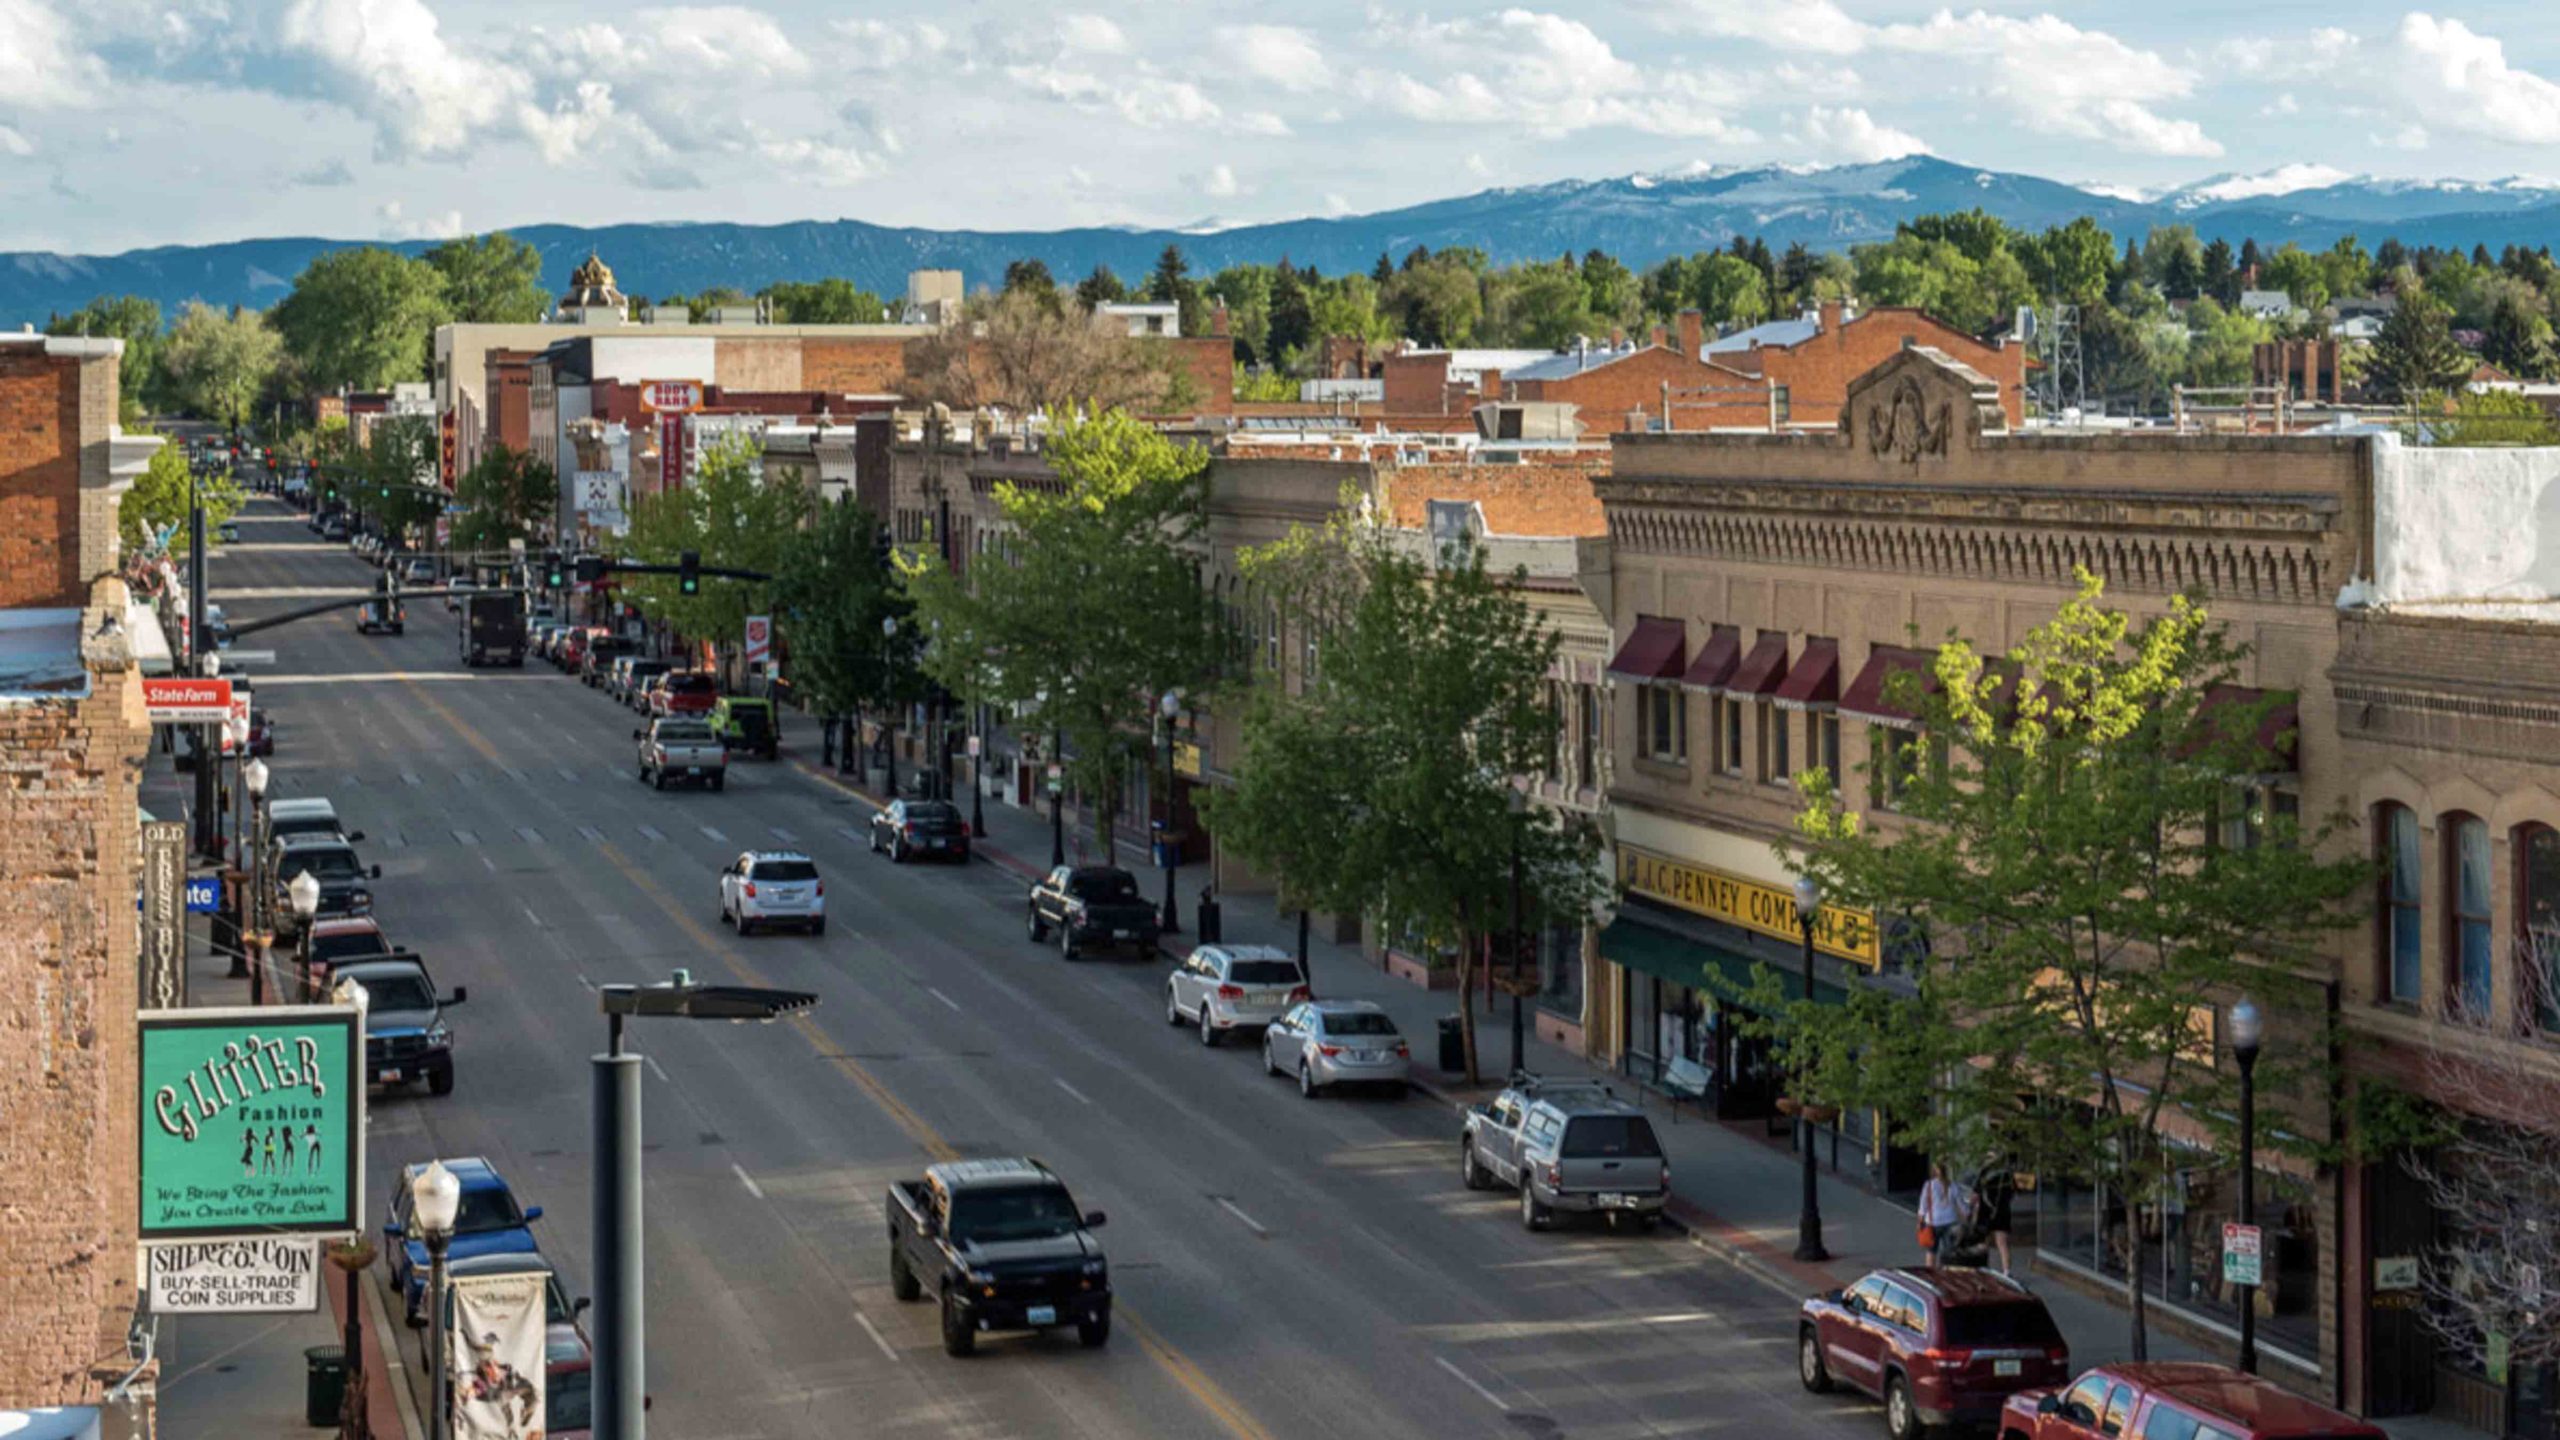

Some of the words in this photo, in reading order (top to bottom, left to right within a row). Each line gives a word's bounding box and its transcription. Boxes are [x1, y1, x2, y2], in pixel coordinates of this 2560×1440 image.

[146, 827, 184, 842] OLD
[1749, 890, 1836, 945] COMPNY
[154, 1033, 326, 1143] GLITTER
[239, 1106, 323, 1121] Fashion
[157, 1186, 181, 1201] We
[186, 1185, 229, 1202] Bring
[232, 1183, 265, 1199] The
[160, 1205, 191, 1222] You
[196, 1203, 249, 1218] Create
[252, 1201, 285, 1216] The
[290, 1199, 327, 1214] Look
[218, 1249, 256, 1269] CO.
[263, 1239, 312, 1273] COIN
[167, 1291, 210, 1305] COIN
[216, 1290, 296, 1305] SUPPLIES
